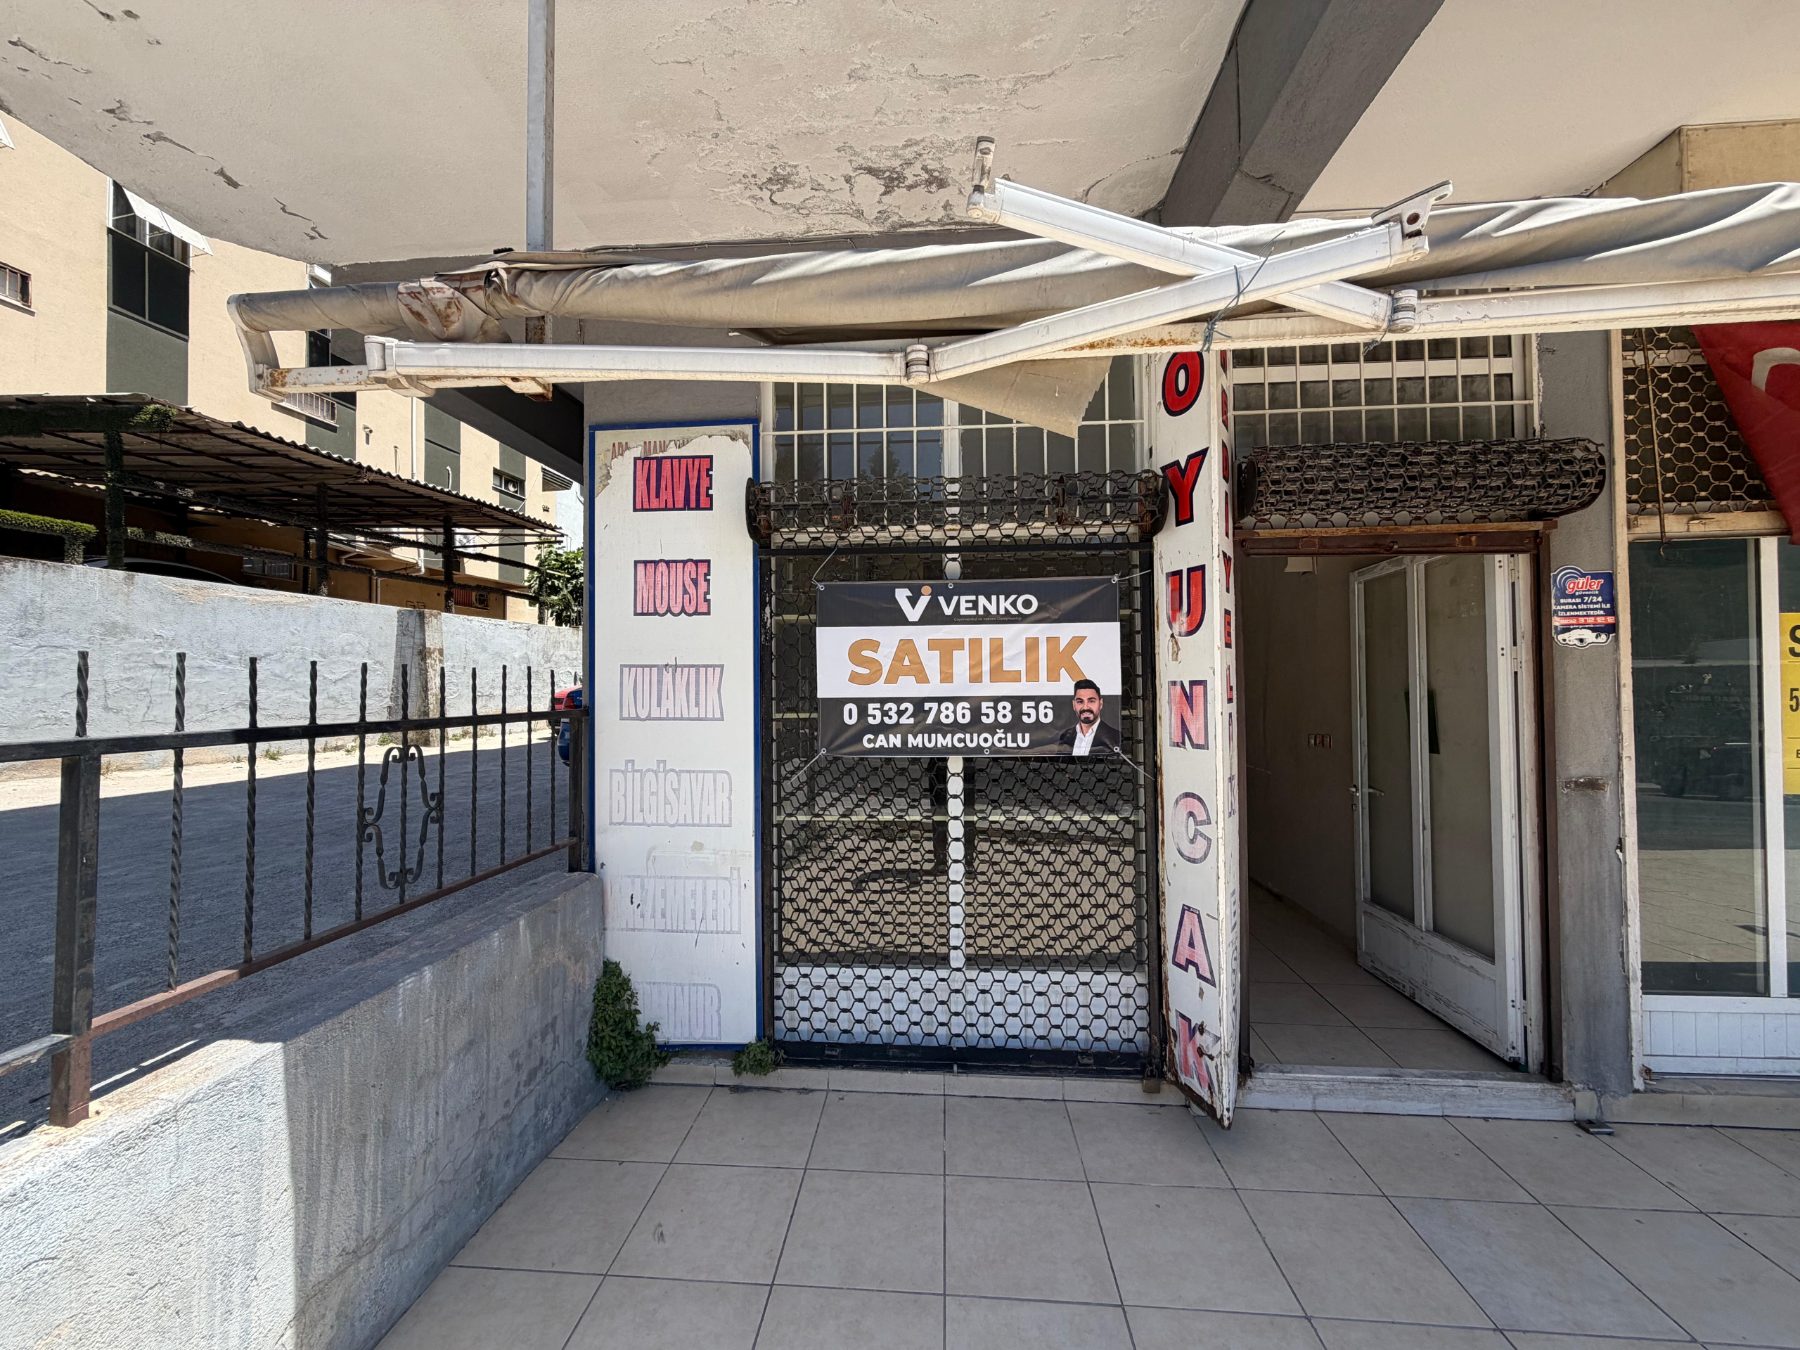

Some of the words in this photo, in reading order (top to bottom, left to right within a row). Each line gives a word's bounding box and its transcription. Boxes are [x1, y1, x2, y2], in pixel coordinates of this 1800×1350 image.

[633, 455, 713, 512] KLAVYE
[633, 558, 711, 617] MOUSE
[938, 594, 1038, 615] VENKO
[1567, 576, 1604, 594] güler
[847, 636, 1088, 686] SATILIK
[619, 664, 724, 722] KULAKLIK
[843, 703, 858, 725] 0
[867, 702, 914, 725] 532
[924, 702, 971, 724] 786
[980, 701, 1012, 724] 58
[1021, 701, 1053, 724] 56
[862, 733, 901, 749] CAN
[907, 729, 1030, 749] MUMCUOĞLU
[609, 760, 732, 828] BİLGİSAYAR
